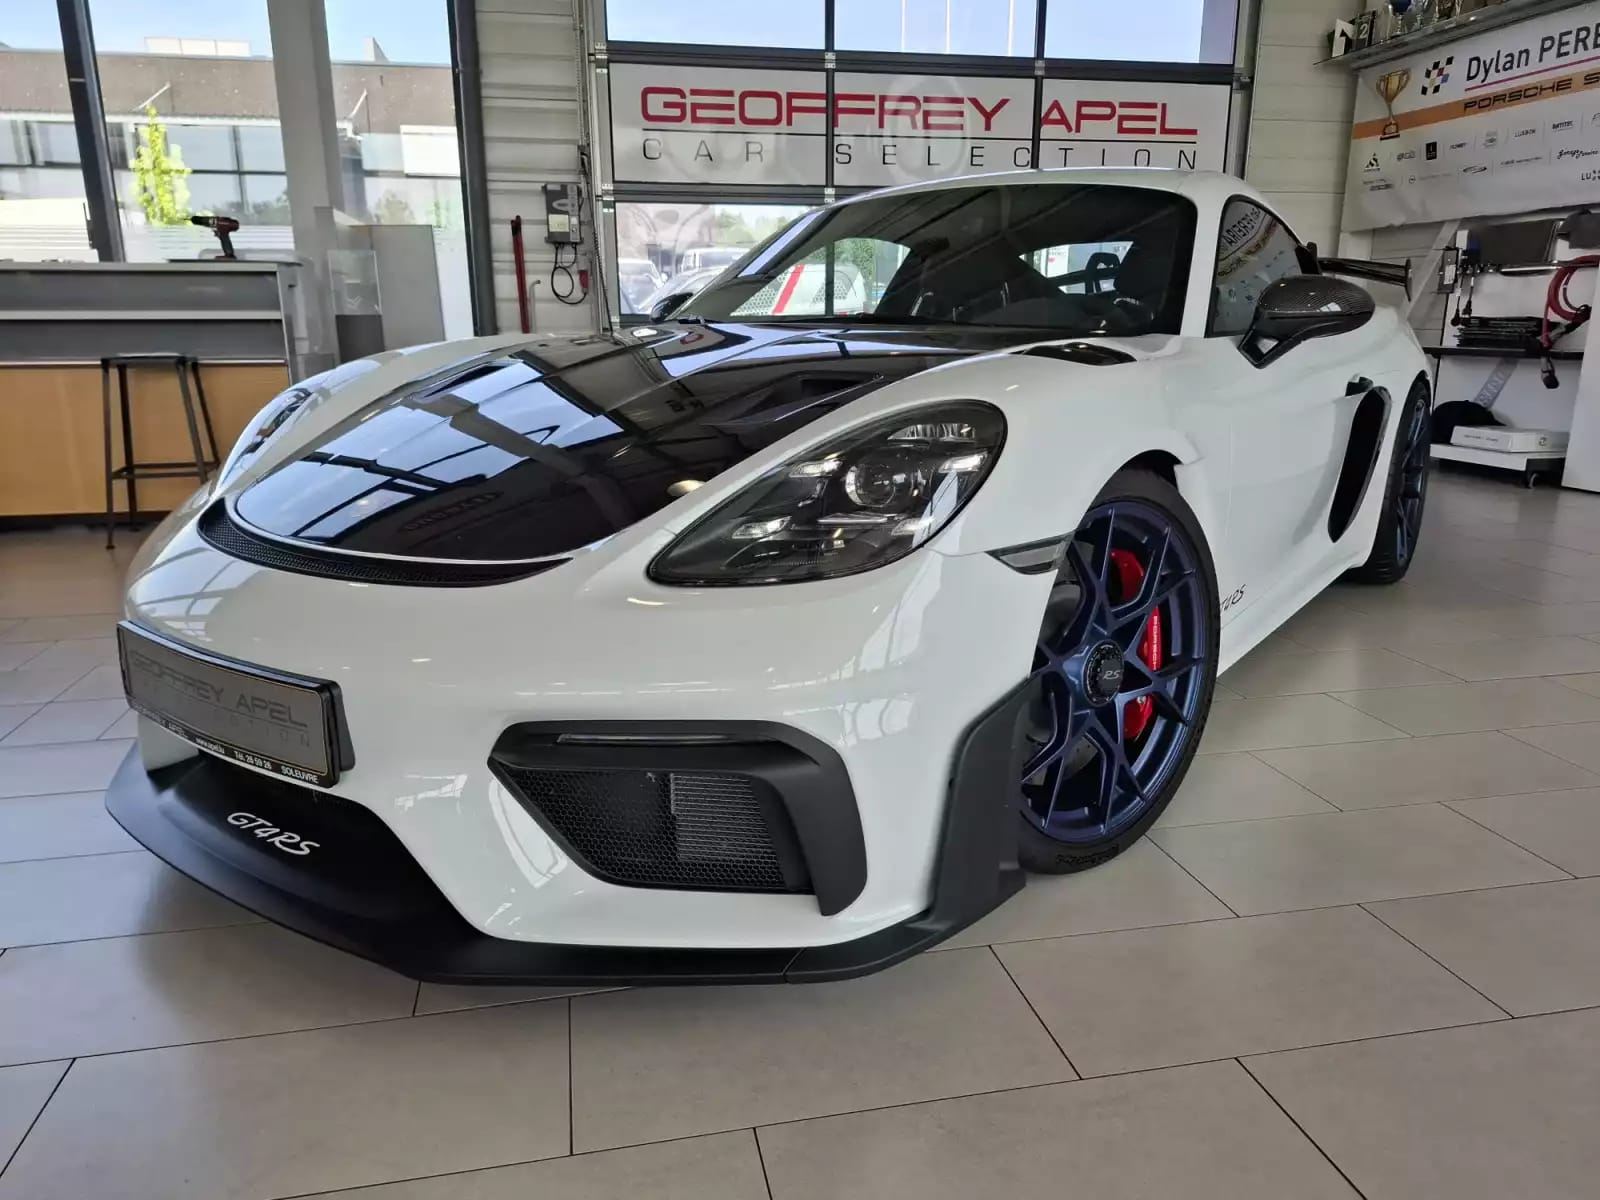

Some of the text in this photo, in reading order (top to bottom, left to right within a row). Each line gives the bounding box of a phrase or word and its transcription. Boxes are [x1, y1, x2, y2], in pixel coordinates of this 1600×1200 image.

[1466, 50, 1531, 84] Dylan
[640, 86, 1198, 135] GEOFFREY APEL
[1463, 78, 1573, 114] PORSCHE
[642, 138, 1196, 170] CAR SELECTION
[236, 692, 308, 729] APEL
[280, 765, 319, 784] SOLEUVRE
[227, 812, 321, 856] GT4RS
